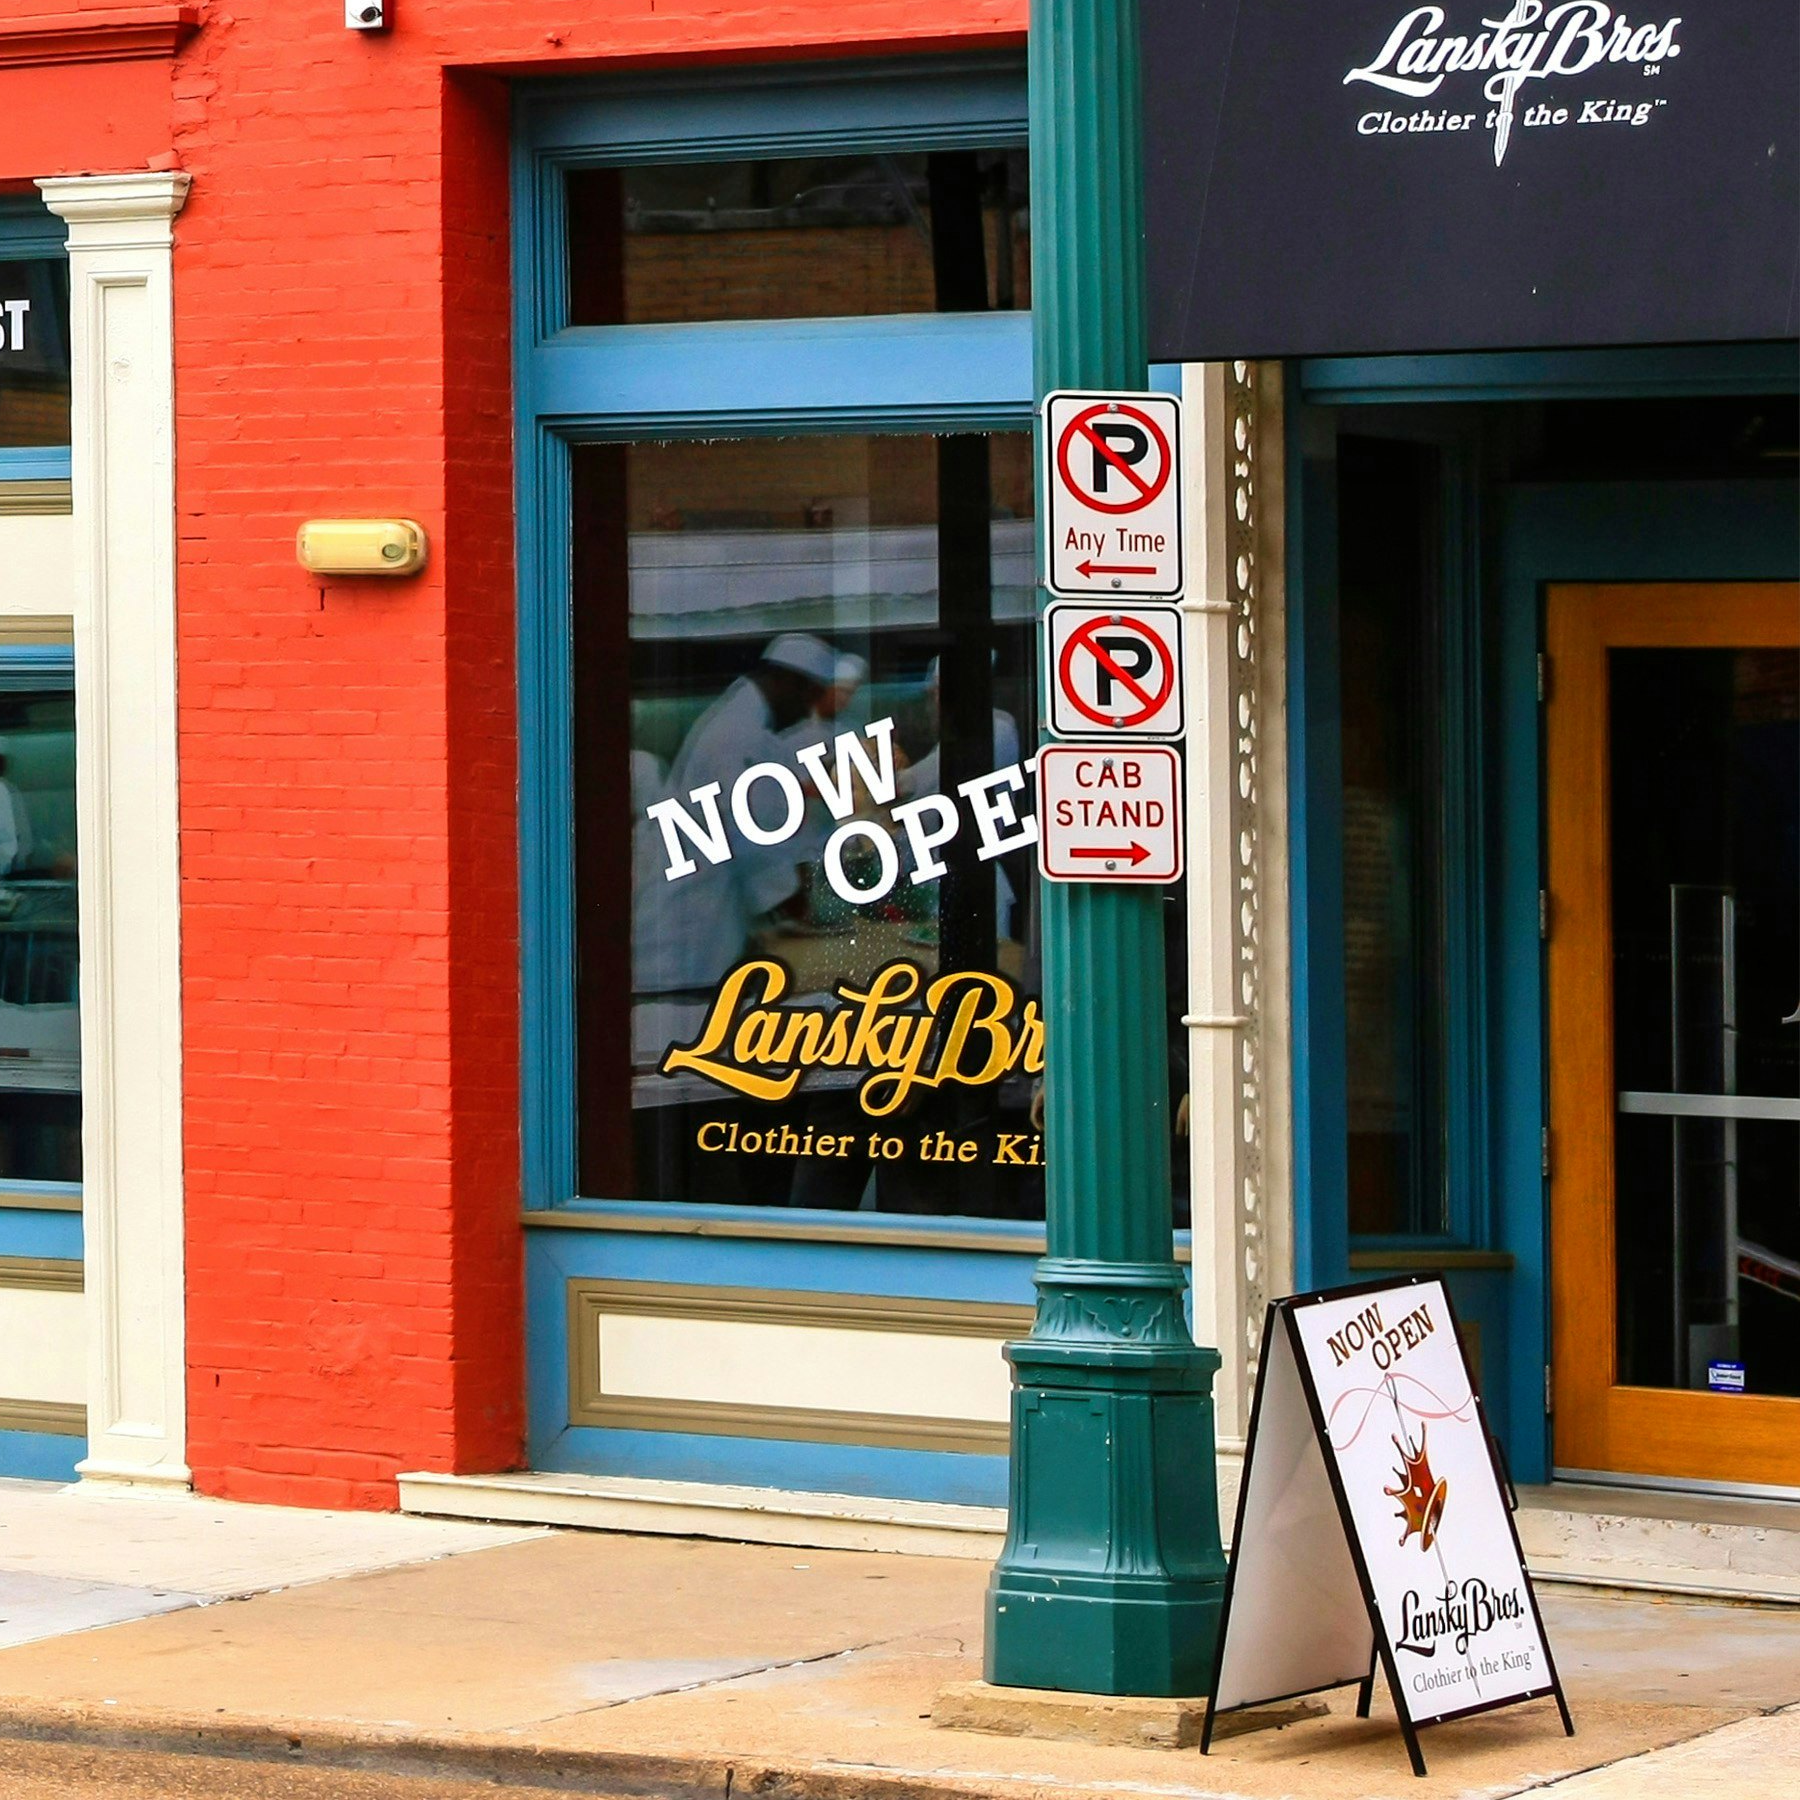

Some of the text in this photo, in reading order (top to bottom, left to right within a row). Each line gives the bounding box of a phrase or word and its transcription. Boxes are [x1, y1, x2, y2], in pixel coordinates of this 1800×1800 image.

[1343, 0, 1682, 101] Lansky Bros.
[1356, 110, 1475, 135] Clothier
[1485, 111, 1513, 130] to
[1523, 104, 1569, 127] the
[1065, 527, 1166, 557] Any Time
[646, 716, 896, 882] NOW
[1075, 761, 1142, 789] CAB
[823, 758, 1039, 904] OPE
[1055, 800, 1165, 829] STAND
[663, 960, 935, 1117] Lansky
[696, 1122, 1046, 1165] Clothier to the Ki
[1326, 1301, 1384, 1368] NOW
[1372, 1303, 1435, 1371] OPEN
[1395, 1578, 1525, 1658] Lansky Bros.
[1413, 1667, 1462, 1693] Clothier
[1465, 1665, 1477, 1679] to
[1480, 1657, 1499, 1676] the
